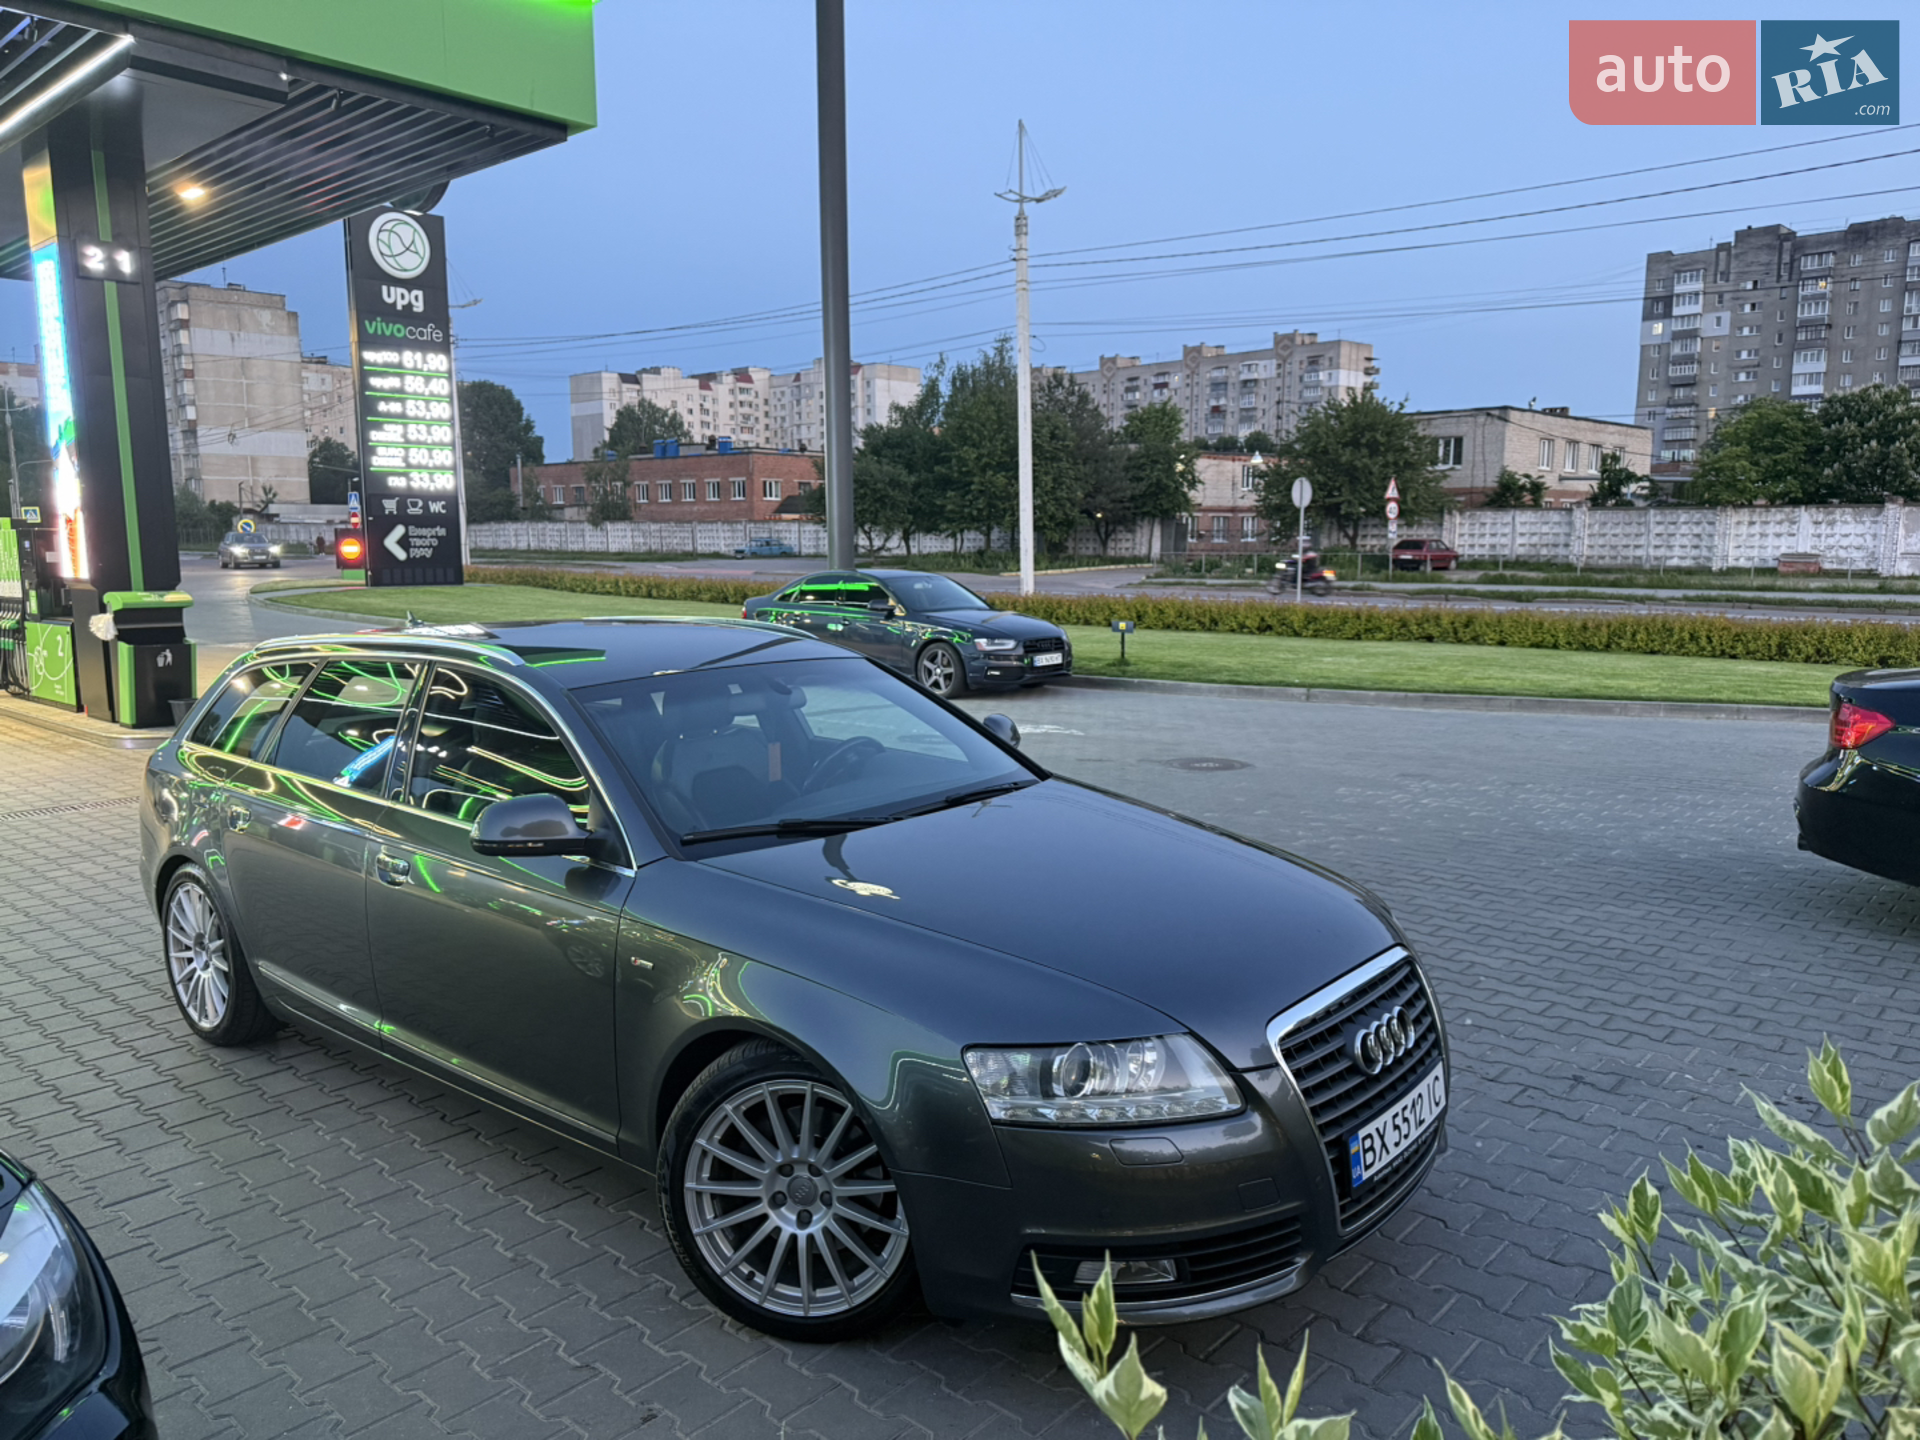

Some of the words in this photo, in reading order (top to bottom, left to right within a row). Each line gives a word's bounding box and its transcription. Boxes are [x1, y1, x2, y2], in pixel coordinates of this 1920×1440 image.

[82, 246, 105, 270] 2
[381, 285, 424, 313] upg
[402, 350, 449, 372] 61,90
[405, 399, 451, 420] 53,90
[407, 423, 452, 444] 53,90
[408, 447, 454, 468] 50,90
[409, 471, 455, 491] 33,90
[428, 501, 447, 514] WC
[1361, 1121, 1390, 1172] BX
[1391, 1092, 1425, 1148] 5512
[1427, 1075, 1442, 1116] IC
